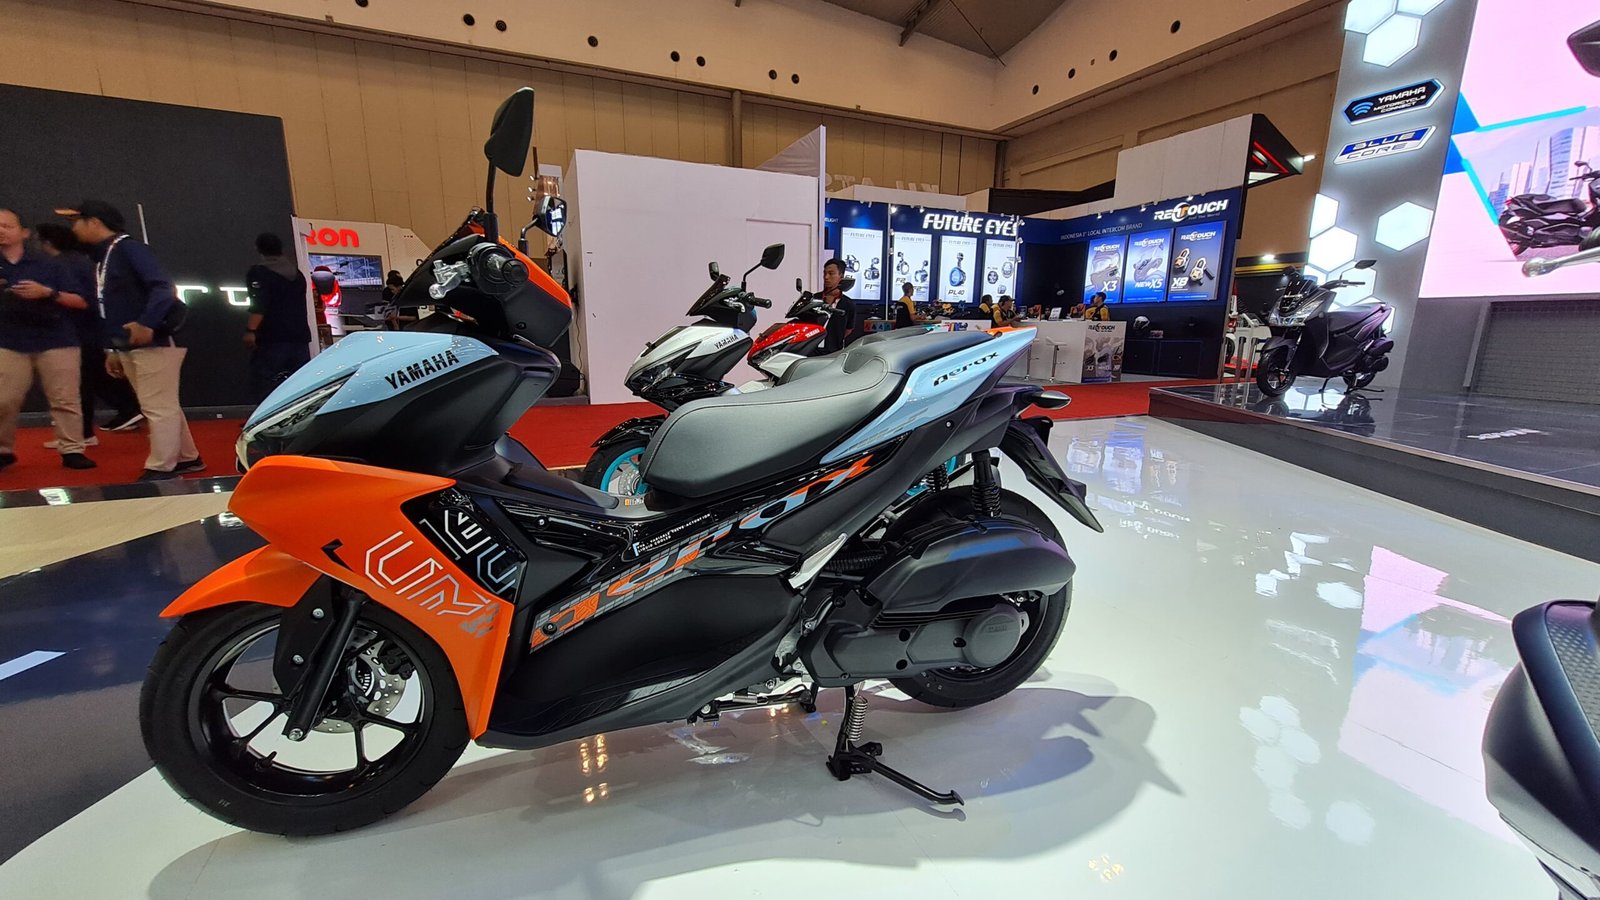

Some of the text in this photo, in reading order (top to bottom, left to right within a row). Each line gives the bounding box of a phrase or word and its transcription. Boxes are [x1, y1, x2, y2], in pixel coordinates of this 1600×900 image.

[1373, 95, 1426, 111] MOTORCYCLE
[1378, 86, 1426, 104] YAMAHA
[1353, 131, 1415, 150] BLUE
[1346, 142, 1407, 160] CORE
[1153, 199, 1229, 222] RETOUCH
[922, 213, 1017, 236] FUTURE EYES
[1088, 229, 1101, 237] LOCAL
[1102, 225, 1125, 234] INTERCOM
[1125, 222, 1143, 230] BRAND
[1181, 231, 1216, 241] RETOUCH
[1101, 280, 1118, 292] X3
[1134, 281, 1150, 289] NEW
[1149, 278, 1164, 289] X5
[714, 334, 739, 350] YAMAHA
[384, 349, 460, 390] YAMAHA
